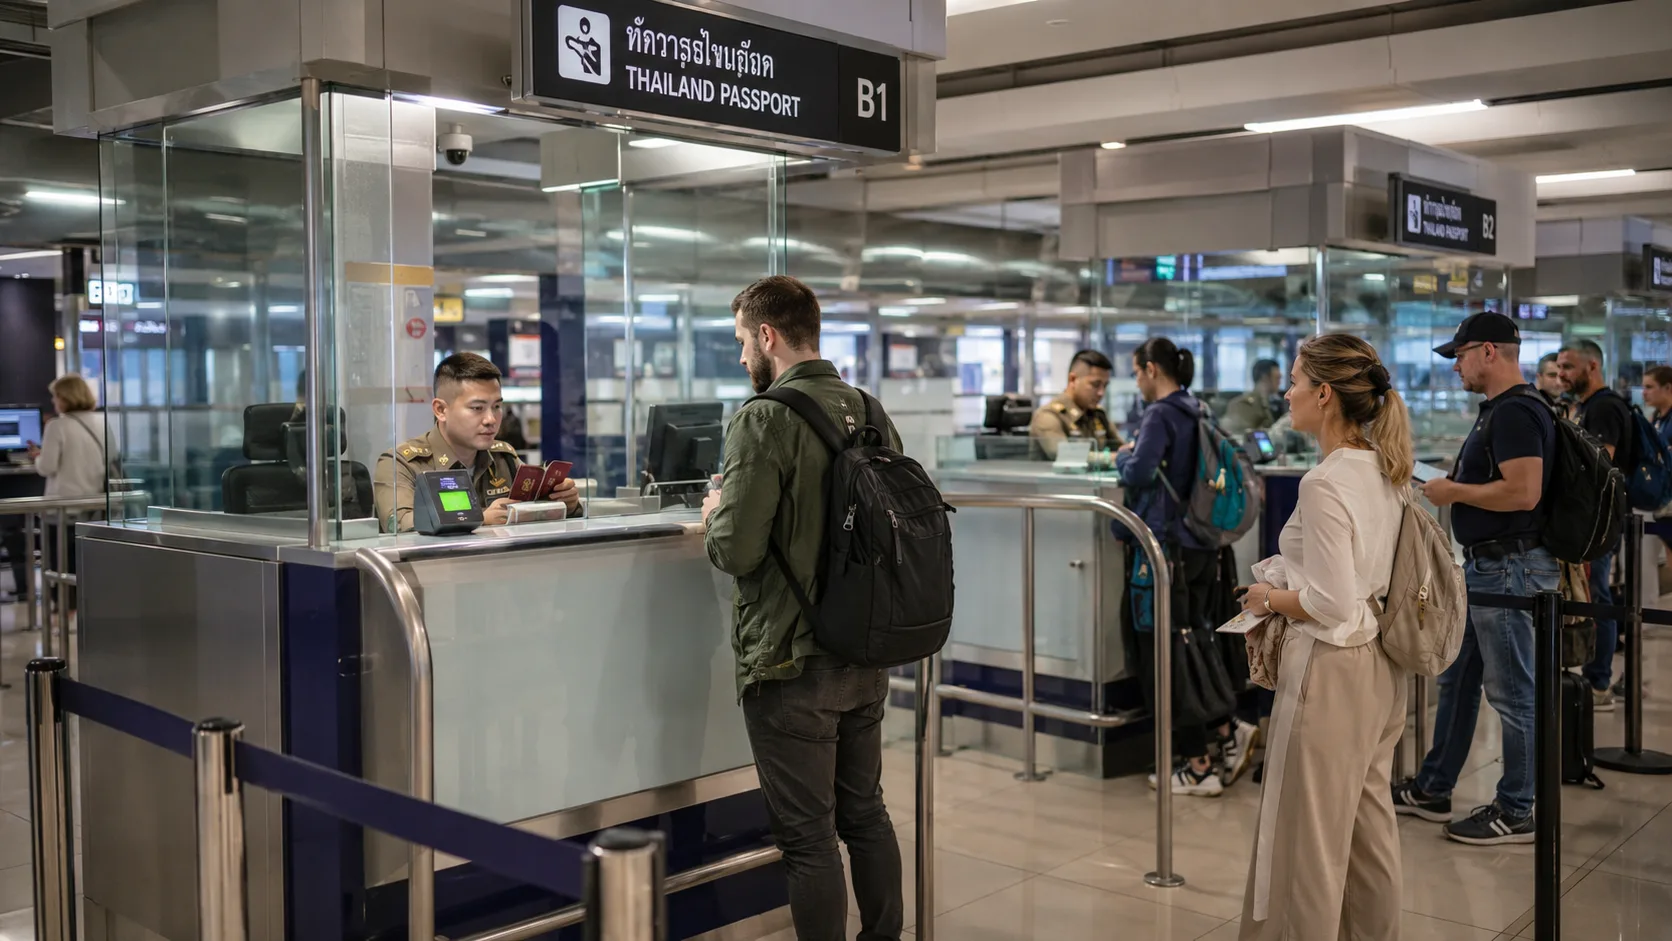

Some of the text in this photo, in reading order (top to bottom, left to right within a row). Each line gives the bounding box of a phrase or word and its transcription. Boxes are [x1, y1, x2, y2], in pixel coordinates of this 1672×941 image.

[625, 65, 801, 118] THAILAND PASSPORT
[856, 77, 887, 122] B1
[1482, 213, 1494, 239] B2
